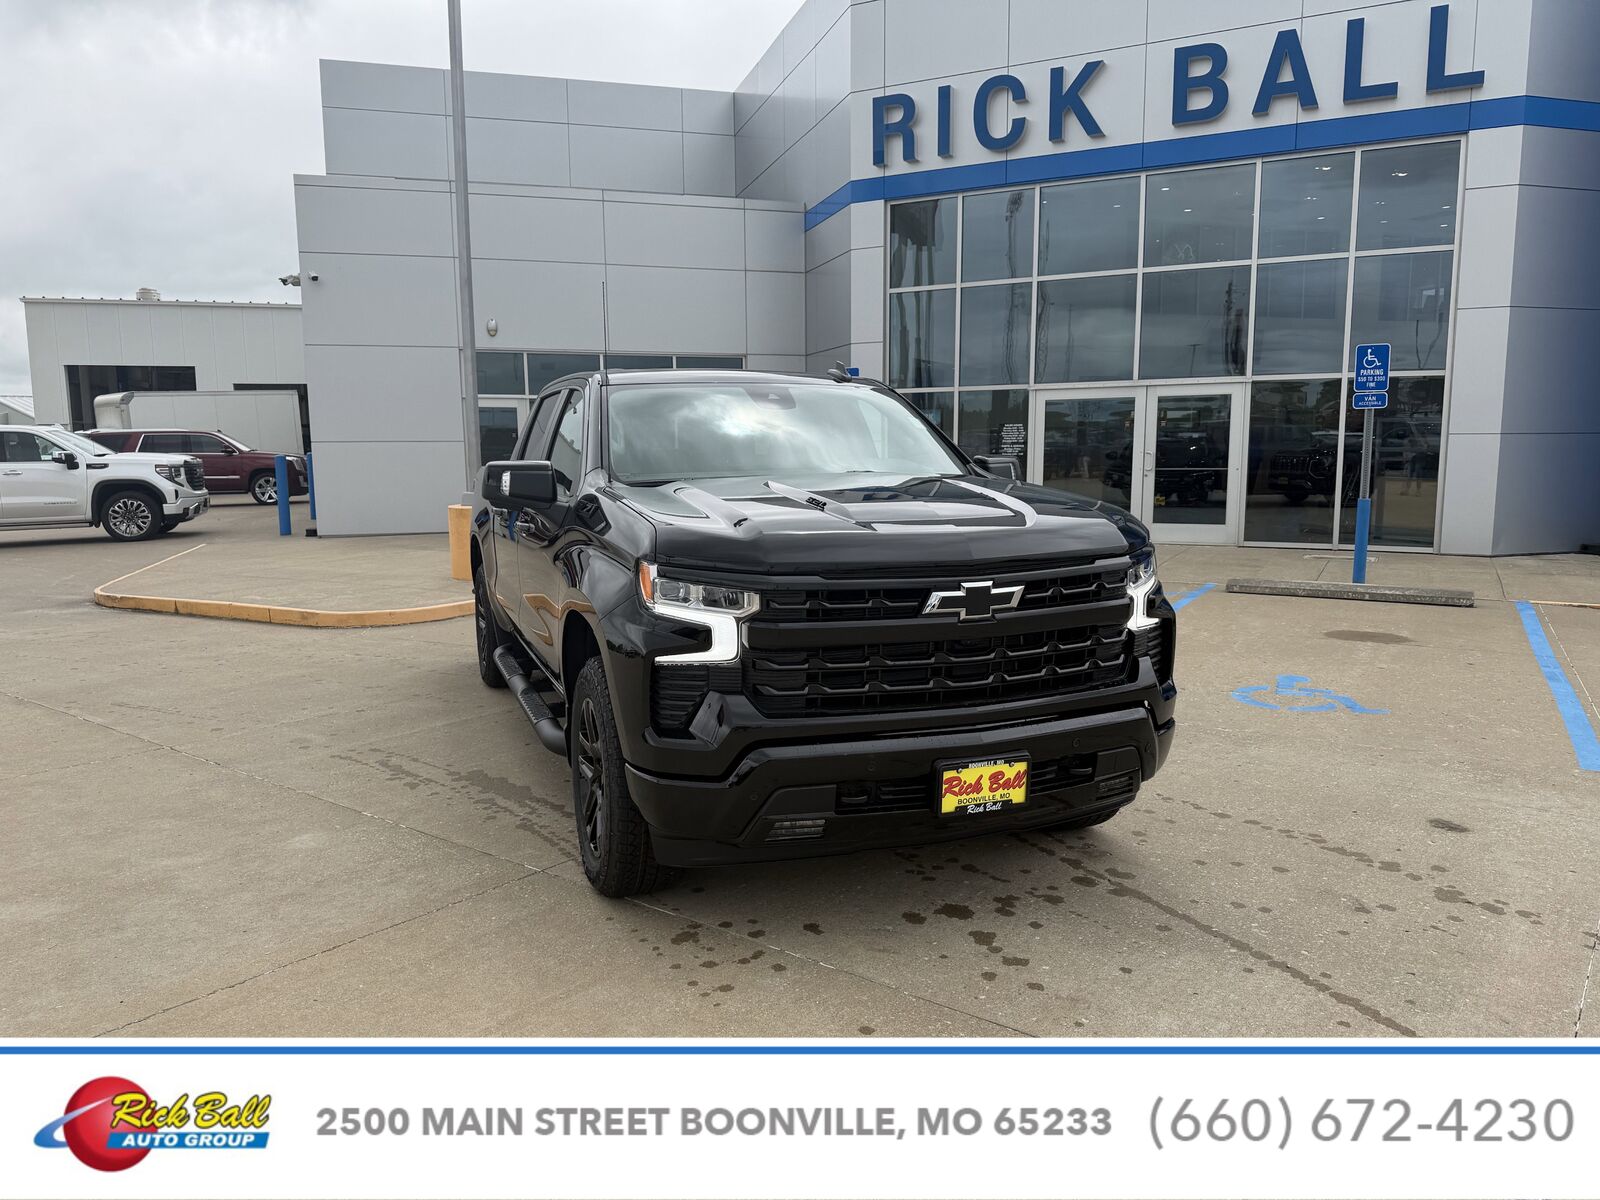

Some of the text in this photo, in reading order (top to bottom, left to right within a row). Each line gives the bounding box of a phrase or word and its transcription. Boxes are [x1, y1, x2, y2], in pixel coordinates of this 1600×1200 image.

[872, 4, 1485, 168] RICK BALL
[942, 769, 1028, 798] Rick Ball
[957, 795, 999, 805] BOONVILLE,
[966, 801, 1002, 815] Rick Ball
